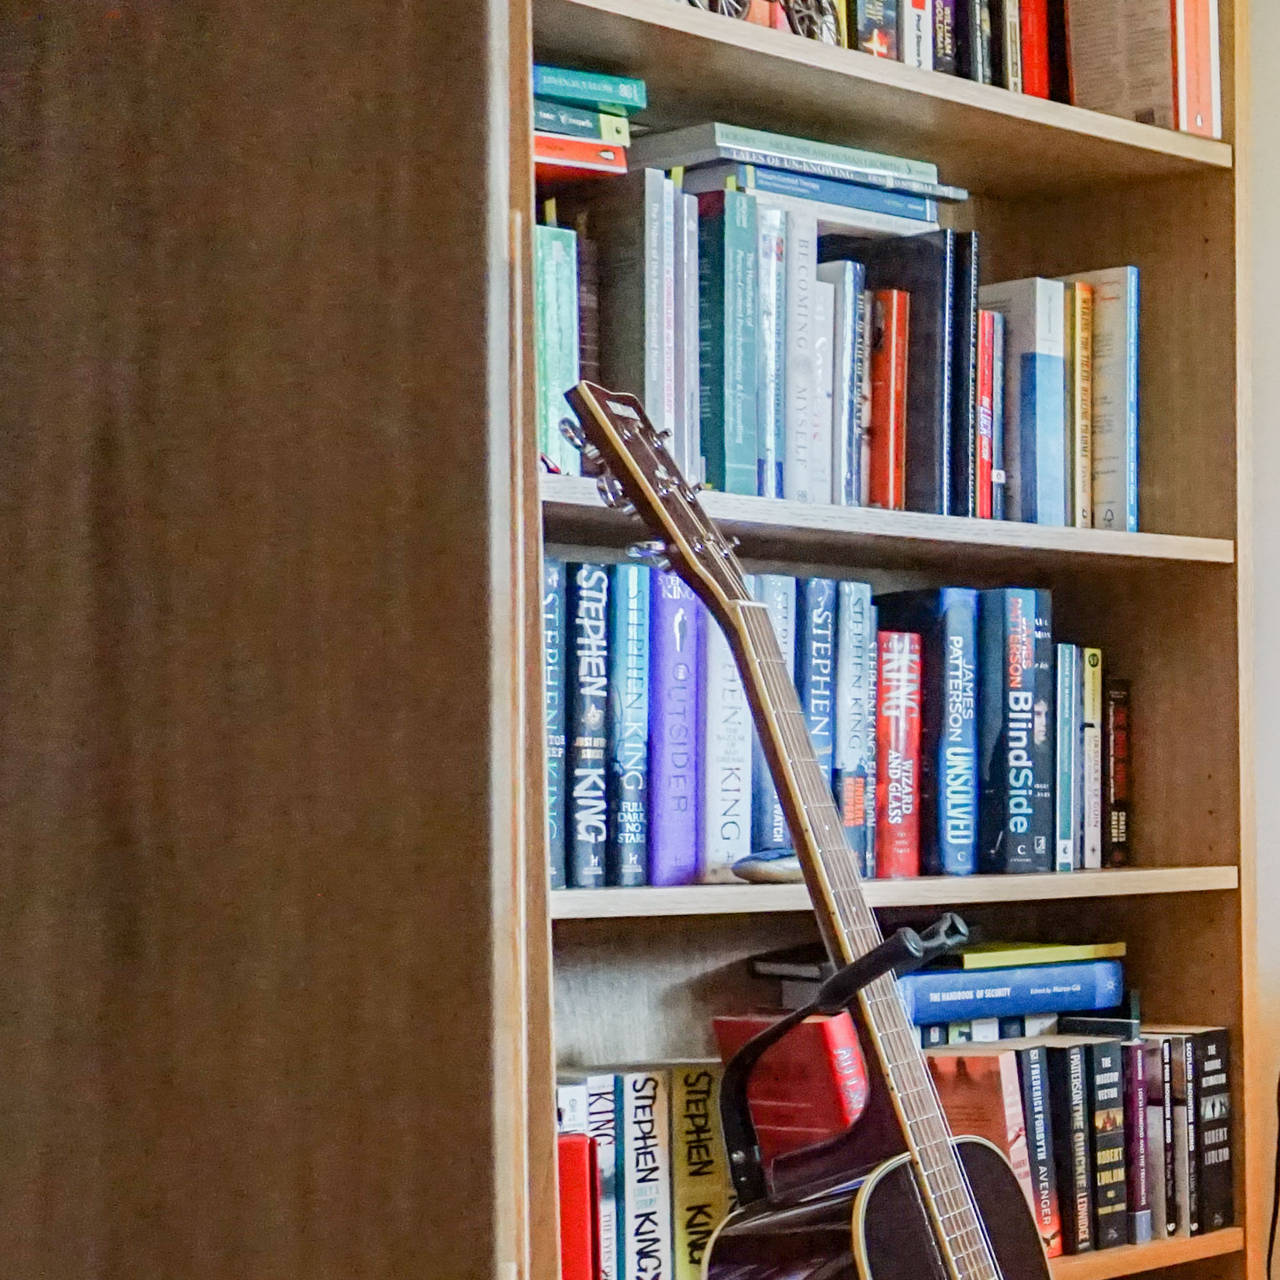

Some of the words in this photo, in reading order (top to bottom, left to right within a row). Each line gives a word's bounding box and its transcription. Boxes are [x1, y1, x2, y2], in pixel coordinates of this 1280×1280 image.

[935, 0, 944, 58] GOLDMAN
[943, 6, 952, 54] WILLIAM
[732, 149, 763, 163] TALES
[764, 154, 782, 167] OF
[746, 252, 754, 268] The
[746, 271, 754, 315] Handbook
[796, 239, 810, 349] BECOMING
[796, 385, 809, 469] MYSELF
[575, 566, 608, 697] STEPHEN
[625, 590, 645, 709] STEPHEN
[851, 597, 864, 690] STEPHEN
[1008, 598, 1022, 688] PATTERSON
[1021, 617, 1033, 669] JAMES
[544, 593, 560, 730] STEPHEN
[811, 608, 832, 736] STEPHEN
[867, 641, 878, 709] STEPHEN
[882, 652, 920, 718] KING
[949, 636, 964, 741] PATTERSON
[962, 660, 974, 720] JAMES
[668, 663, 690, 812] OUTSIDER
[850, 696, 863, 750] KING
[866, 711, 876, 757] KING
[623, 722, 643, 790] KING
[888, 750, 902, 780] AND
[1008, 691, 1033, 833] BlindSide
[573, 768, 607, 843] KING
[621, 801, 644, 812] FULL
[720, 767, 741, 841] KING
[888, 782, 902, 825] GLASS
[901, 759, 913, 815] WIZARD
[946, 747, 974, 844] UNSOLVED
[617, 812, 646, 823] DARK
[625, 823, 641, 833] NO
[772, 801, 784, 842] WATCH
[930, 991, 941, 1002] THE
[942, 989, 974, 1002] HANDBOOK
[976, 989, 984, 999] OF
[985, 987, 1011, 999] SECURITY
[1030, 1064, 1044, 1112] FREDERICK
[1070, 1054, 1083, 1104] PATTERSON
[588, 1091, 616, 1146] KING
[632, 1077, 660, 1183] STEPHEN
[683, 1071, 715, 1177] STEPHEN
[1034, 1113, 1047, 1160] FORSYTH
[1072, 1104, 1084, 1129] THE
[1204, 1127, 1228, 1146] ROBERT
[1074, 1132, 1086, 1187] QUICKIE
[1097, 1147, 1123, 1164] ROBERT
[1038, 1165, 1052, 1225] AVENGER
[1077, 1191, 1089, 1241] LEDWIDGE
[633, 1211, 662, 1273] KING
